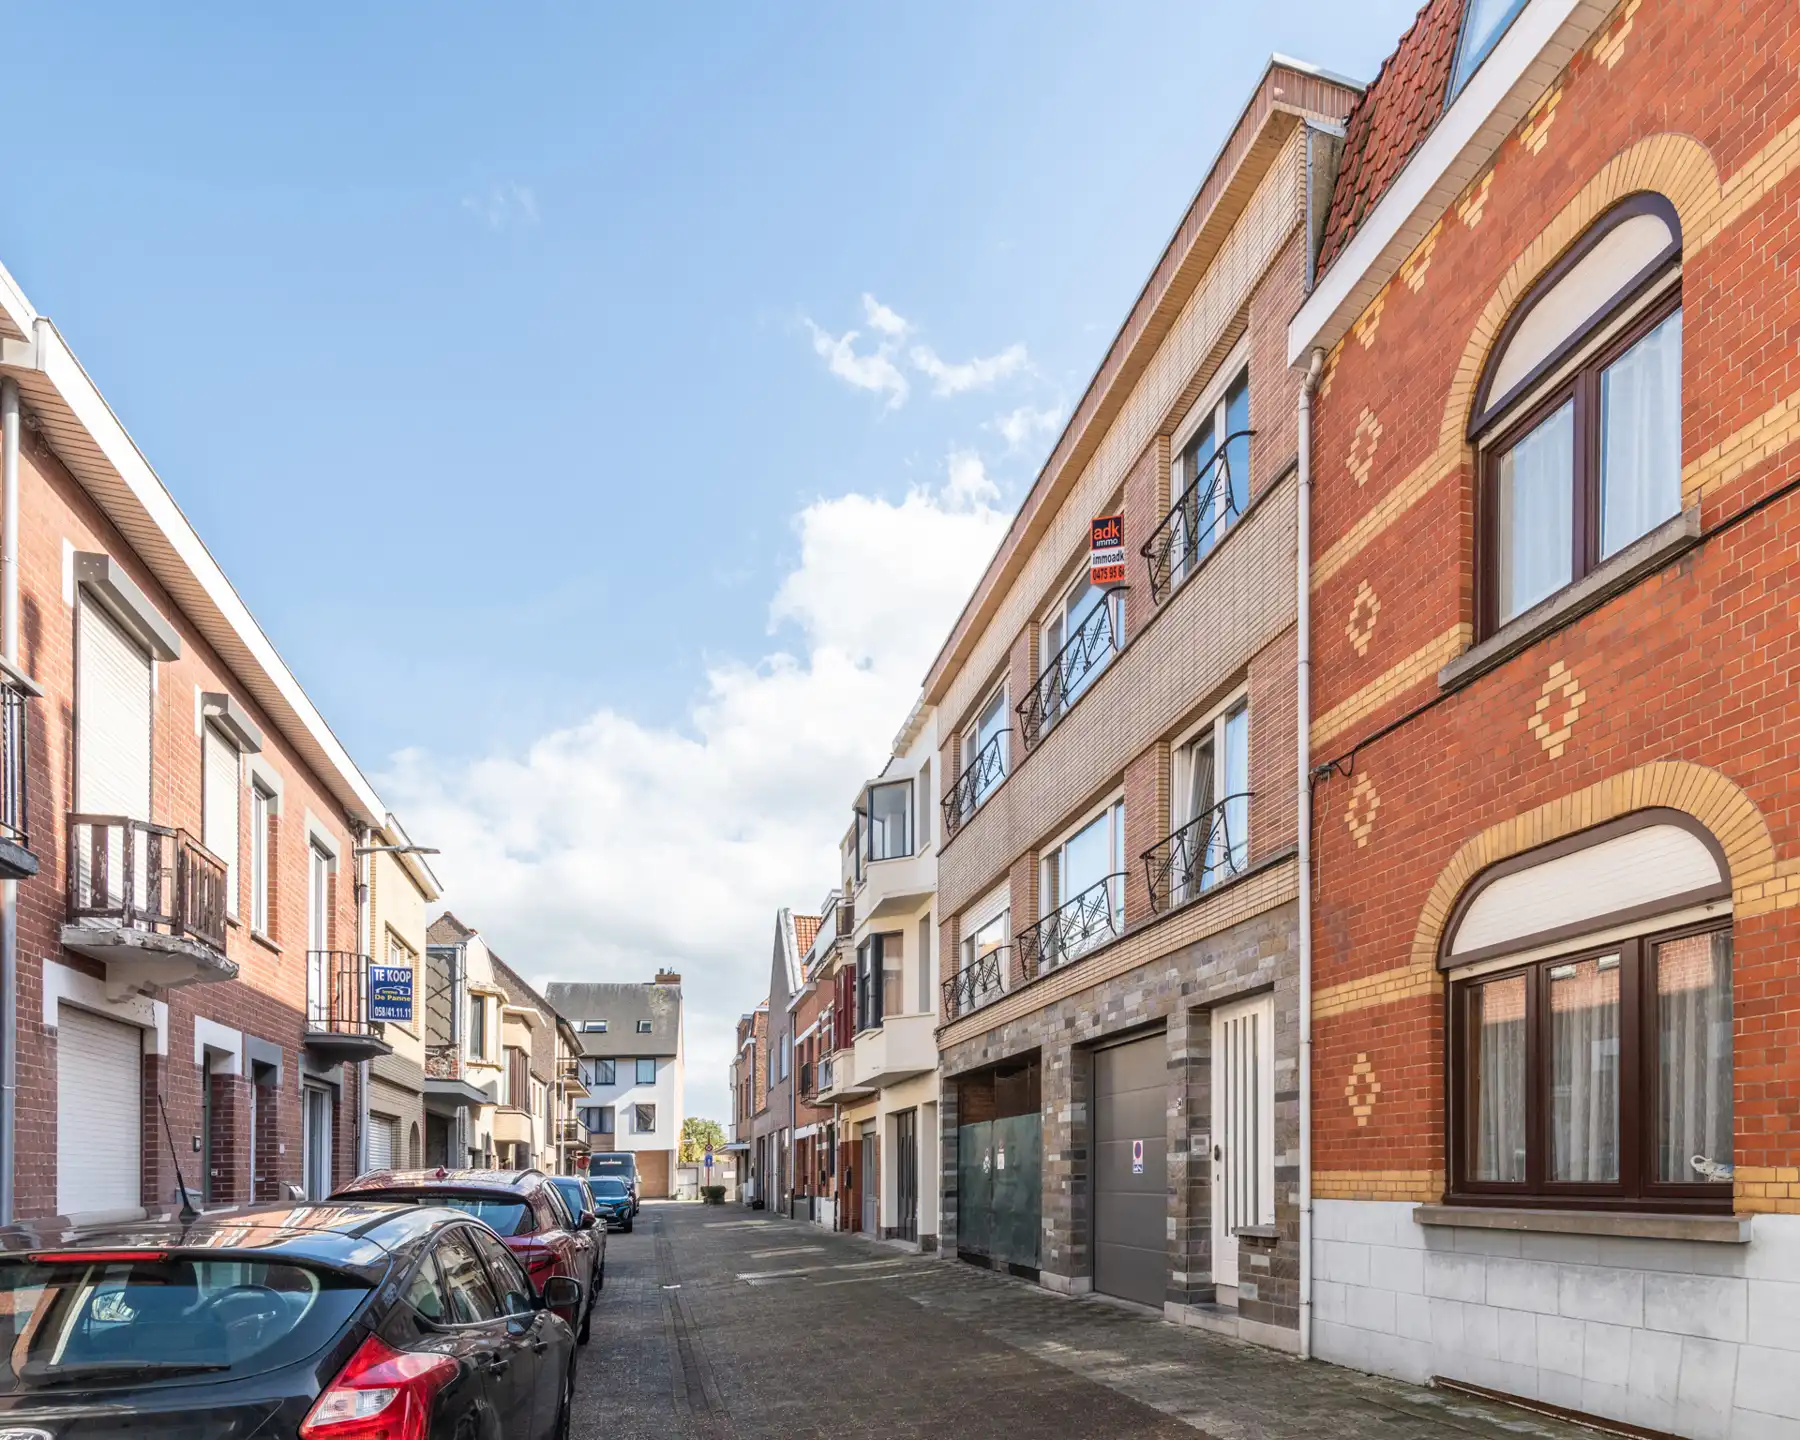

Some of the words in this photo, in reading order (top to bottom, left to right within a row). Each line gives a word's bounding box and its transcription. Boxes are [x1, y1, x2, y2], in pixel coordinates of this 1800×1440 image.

[1094, 520, 1120, 540] adk
[1096, 538, 1118, 546] immo
[1093, 568, 1107, 580] 0475
[374, 969, 385, 981] TE
[387, 970, 411, 983] KOOP
[375, 1007, 411, 1017] 058/41.11.11
